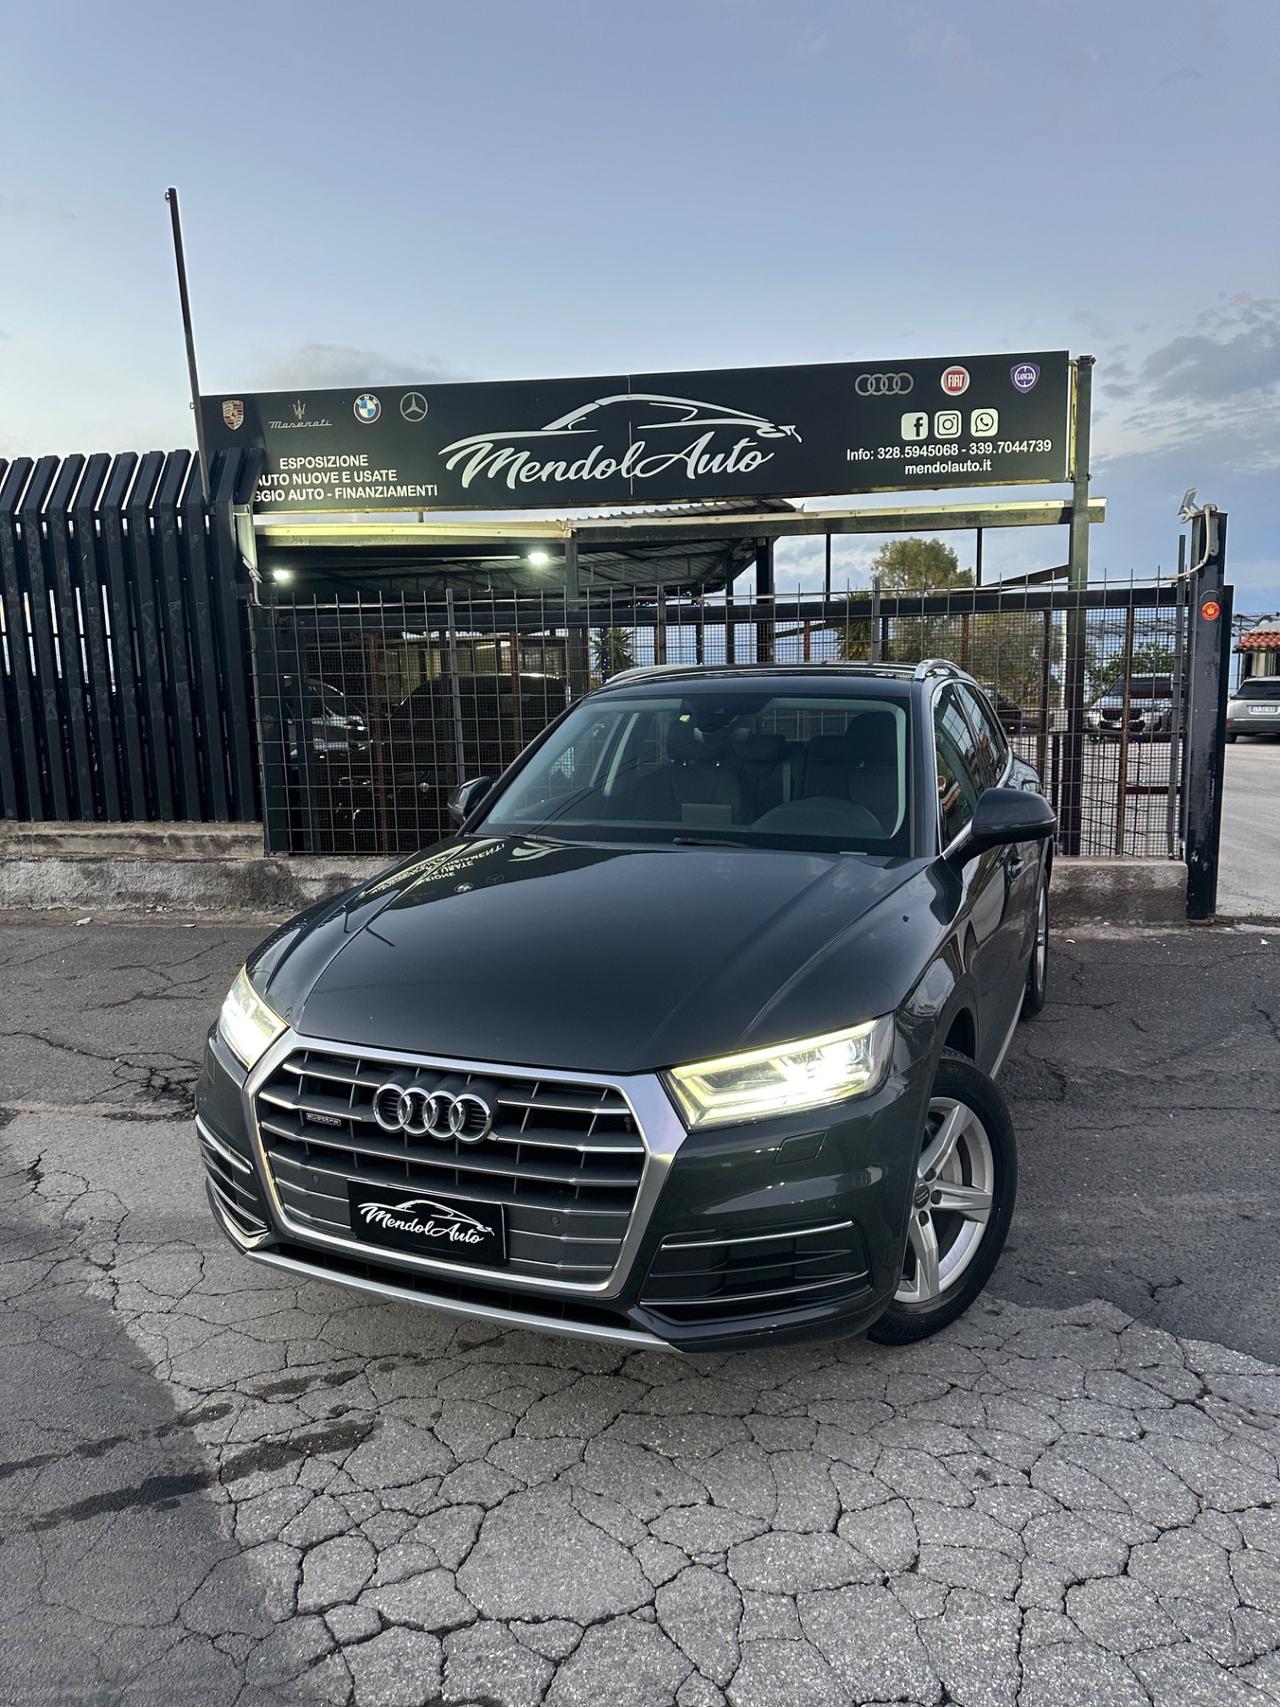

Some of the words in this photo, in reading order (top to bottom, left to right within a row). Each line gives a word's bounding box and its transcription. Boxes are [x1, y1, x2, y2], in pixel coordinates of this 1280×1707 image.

[947, 374, 964, 388] FIAT
[846, 448, 875, 461] Info:
[877, 443, 959, 459] 328.5945068
[969, 439, 1052, 455] 339.7044739
[279, 454, 369, 470] ESPOSIZIONE
[904, 459, 992, 475] mendolauto.it
[292, 471, 339, 485] NUOVE
[343, 471, 351, 483] E
[354, 470, 397, 483] USATE
[288, 488, 325, 501] AUTO
[334, 484, 438, 500] FINANZIAMENTI
